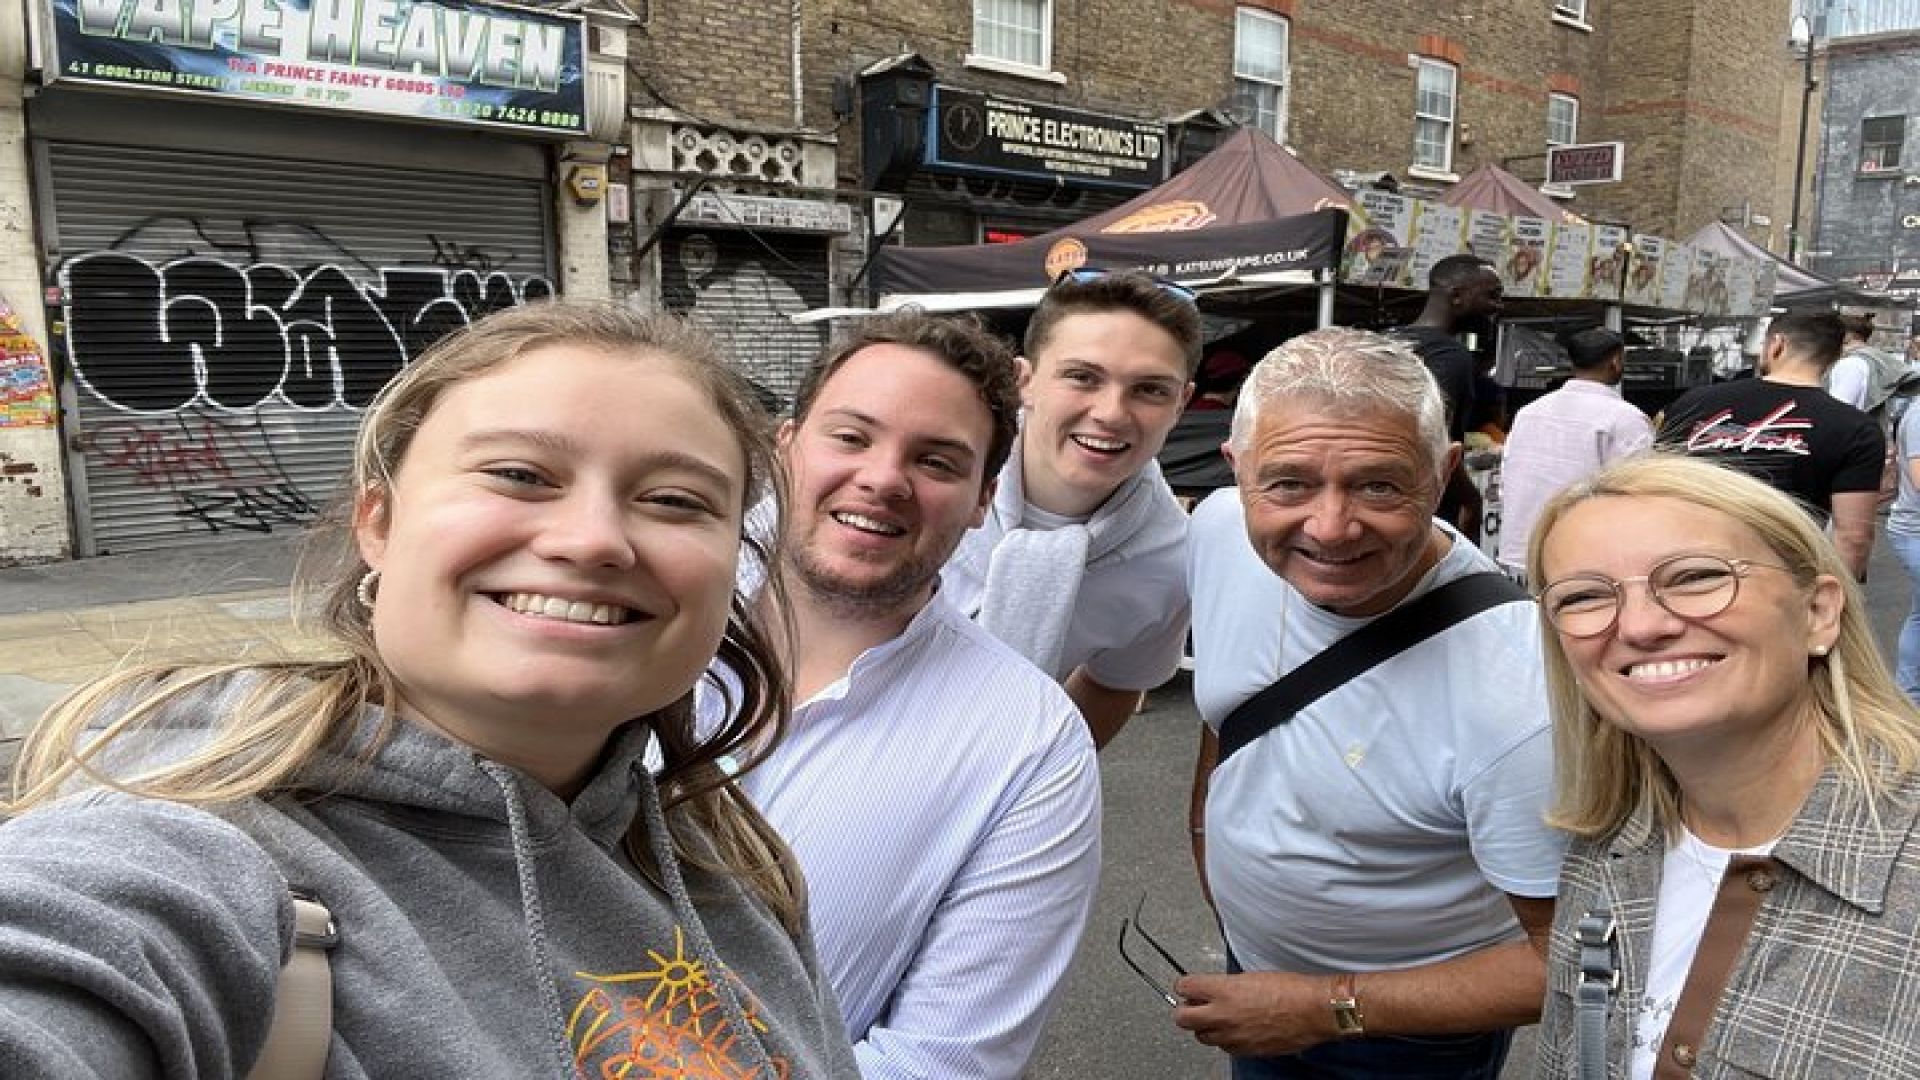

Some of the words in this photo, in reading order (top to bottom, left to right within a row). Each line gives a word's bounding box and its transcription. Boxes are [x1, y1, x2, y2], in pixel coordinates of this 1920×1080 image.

[306, 0, 566, 94] HEAVEN
[68, 60, 89, 74] 41
[95, 63, 173, 83] GOULSTON
[263, 62, 326, 82] PRINCE
[329, 70, 382, 89] FANCY
[385, 77, 434, 96] GOODS
[498, 105, 537, 123] 7426
[987, 108, 1041, 143] PRINCE
[1044, 118, 1134, 157] ELECTRONICS
[1135, 133, 1161, 159] LTD
